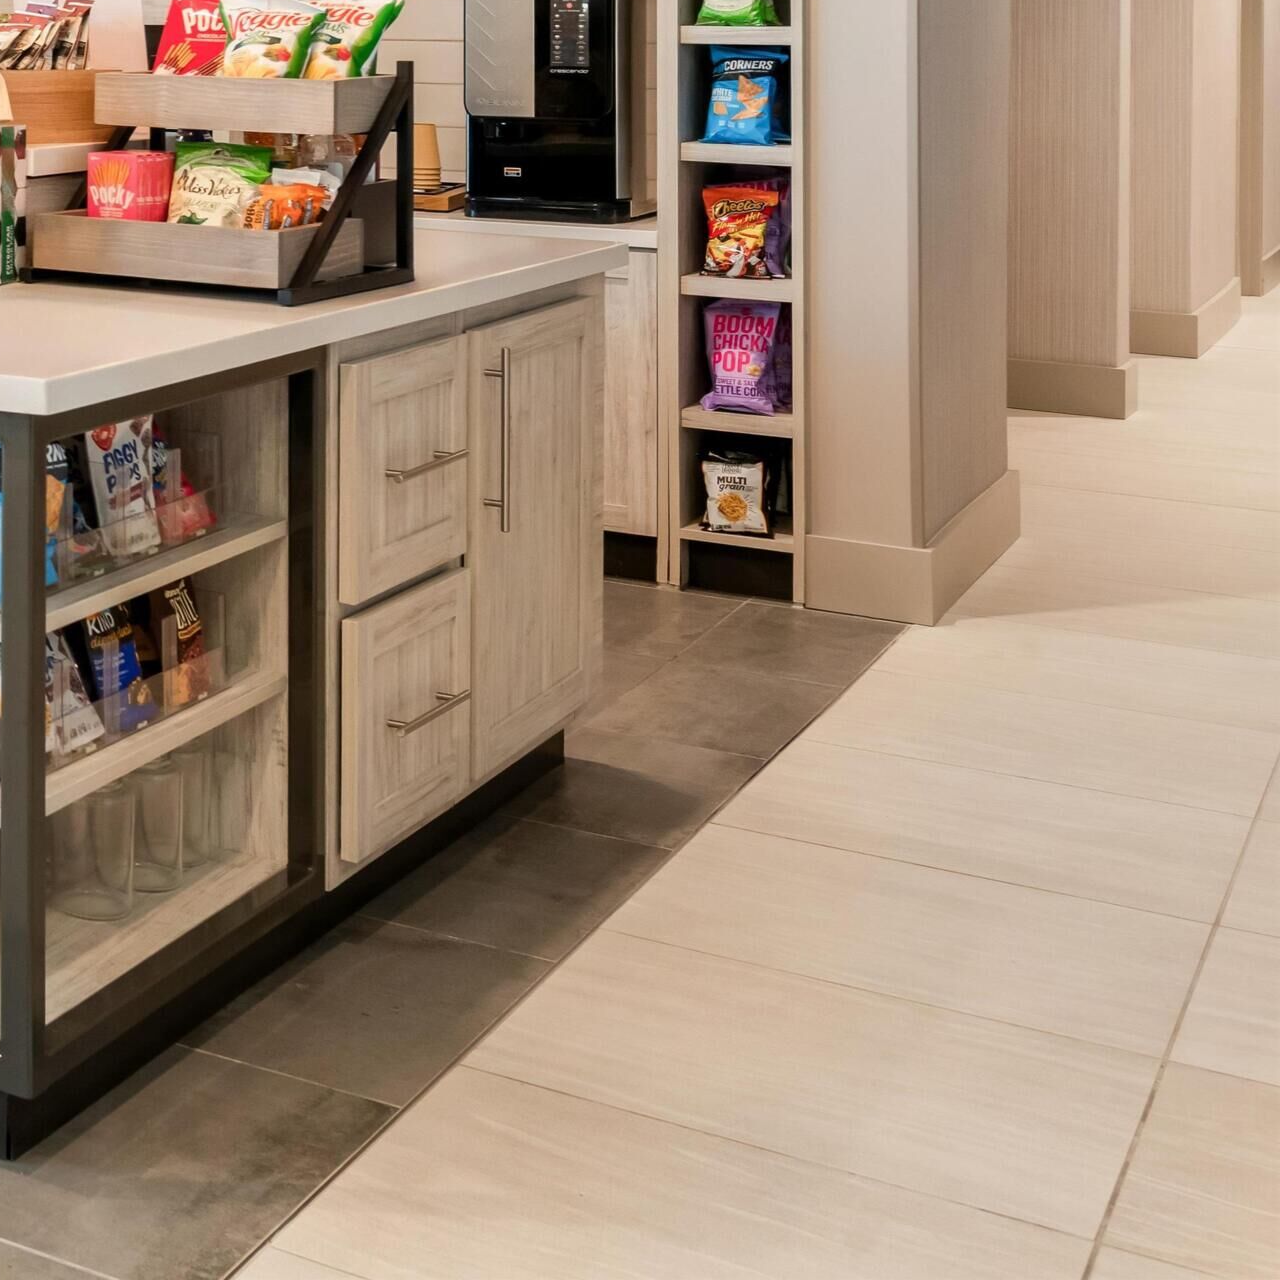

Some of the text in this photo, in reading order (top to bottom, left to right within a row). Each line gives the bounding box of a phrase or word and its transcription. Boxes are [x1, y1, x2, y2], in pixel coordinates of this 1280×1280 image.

[724, 60, 774, 71] CORNERS
[713, 200, 765, 218] Cheetos
[713, 314, 775, 338] BOOM
[713, 334, 769, 353] CHICKA
[712, 350, 752, 373] POP
[714, 385, 742, 396] ETTLE
[102, 439, 139, 475] FIGGY
[717, 475, 747, 485] MULTI
[719, 483, 745, 492] grain
[86, 611, 115, 637] KIND
